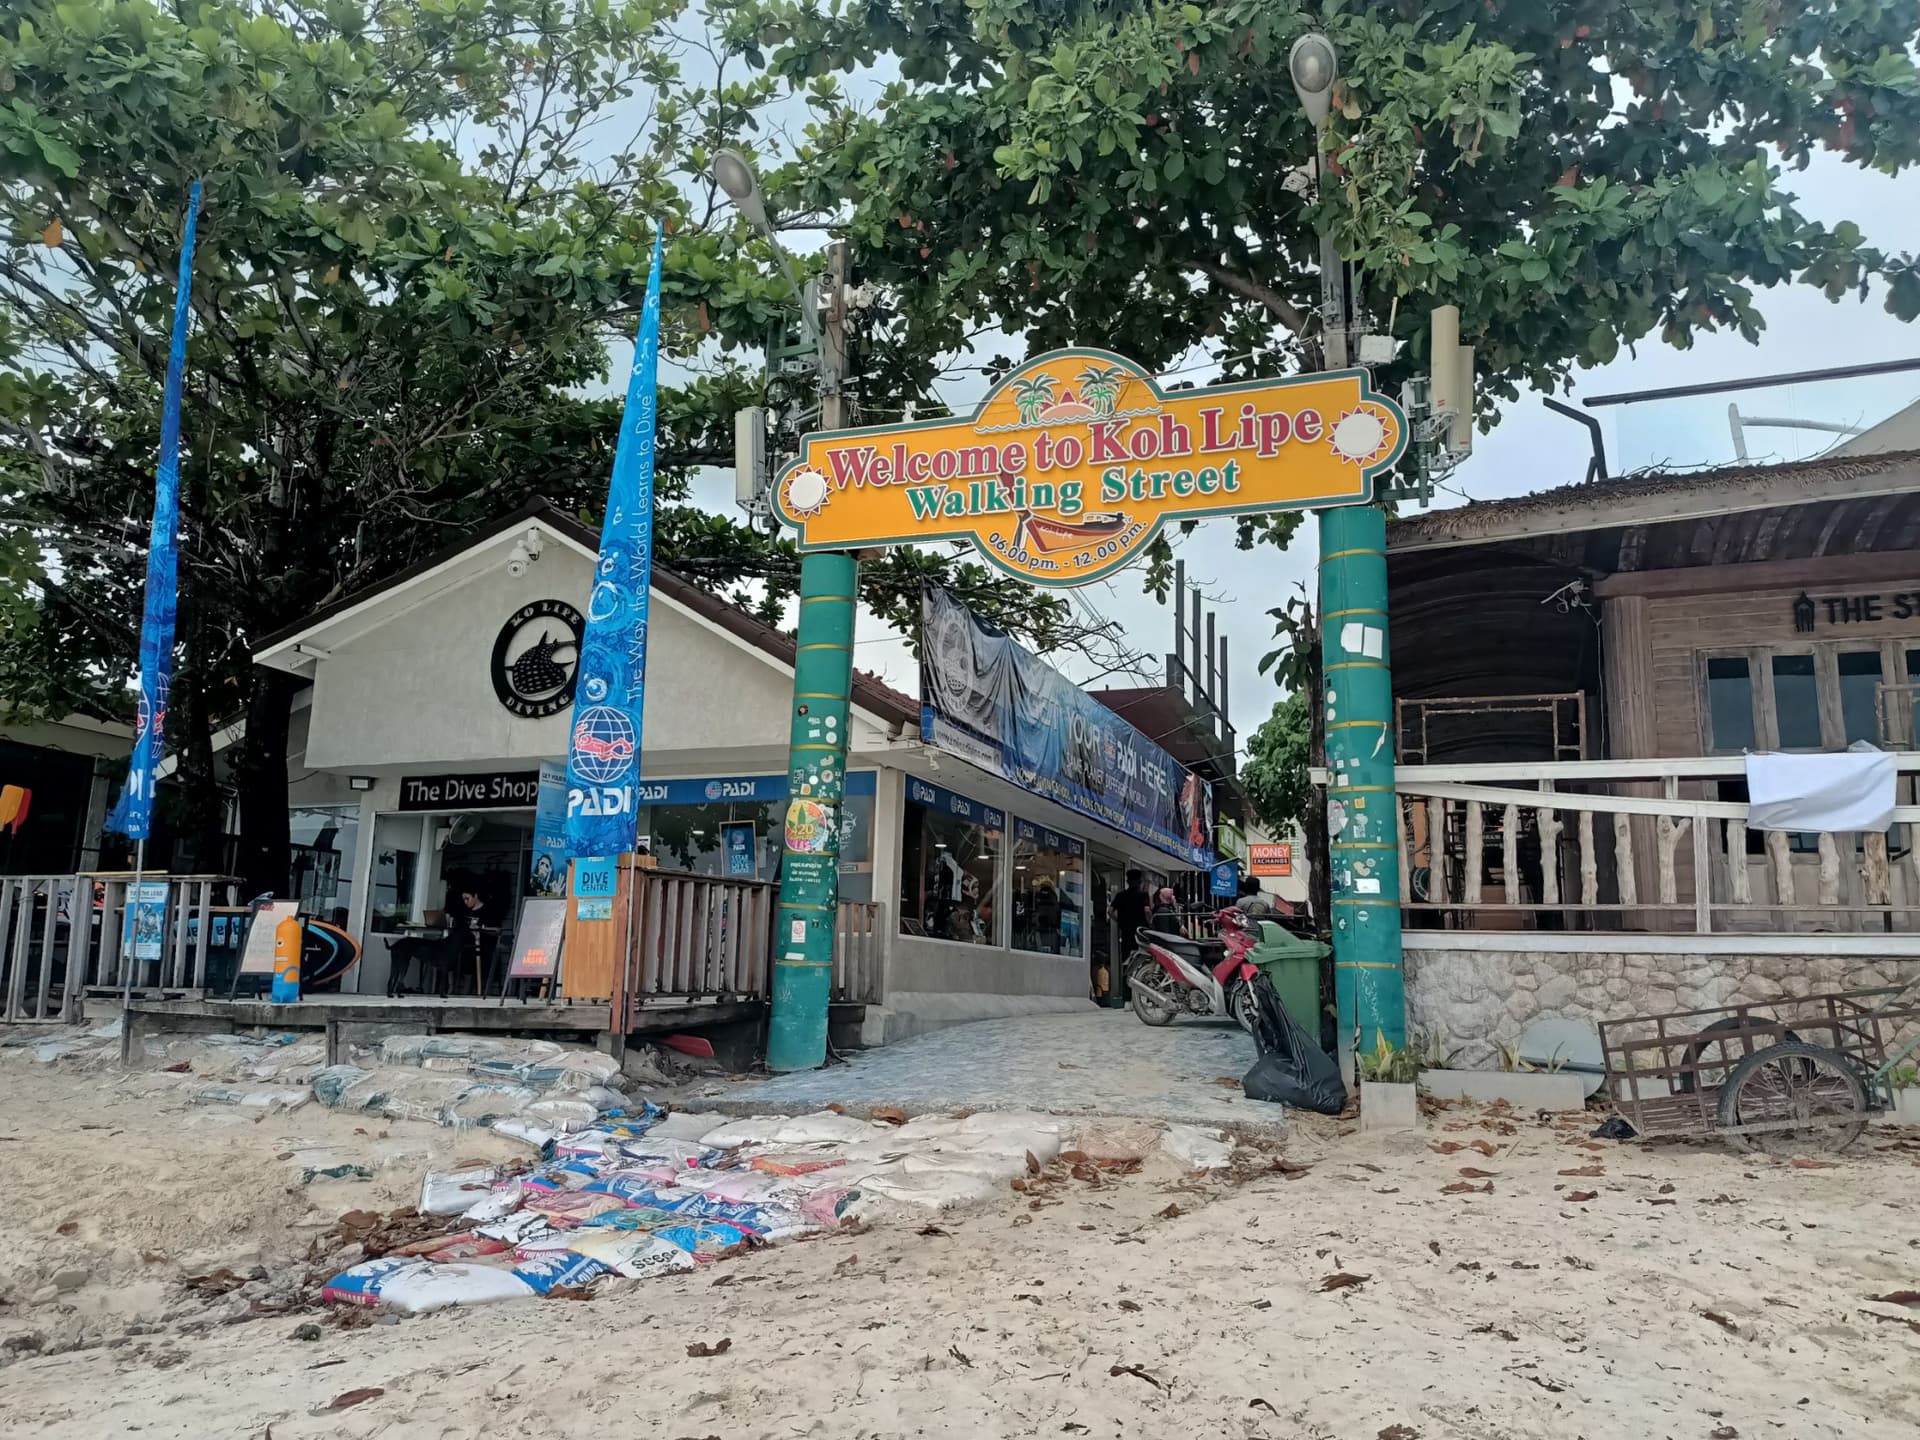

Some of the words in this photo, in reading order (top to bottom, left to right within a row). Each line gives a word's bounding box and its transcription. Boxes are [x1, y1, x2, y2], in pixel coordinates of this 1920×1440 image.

[635, 394, 652, 434] Dive
[637, 439, 651, 457] to
[826, 442, 1027, 490] Welcome
[1034, 431, 1082, 472] to
[1088, 416, 1192, 465] Koh
[1200, 405, 1323, 459] Lipe
[636, 460, 651, 518] Learns
[906, 474, 1084, 522] Walking
[1100, 457, 1242, 504] Street
[631, 519, 648, 583] World
[988, 532, 1029, 564] 06.00
[1028, 557, 1060, 570] pm.
[1072, 540, 1118, 568] 12.00
[1119, 521, 1148, 548] pm.
[511, 606, 535, 627] KO
[541, 602, 581, 625] LIPE
[632, 584, 647, 617] the
[1822, 595, 1883, 625] THE
[628, 618, 647, 666] Way
[626, 668, 643, 704] The
[506, 694, 569, 715] DIVING
[1067, 710, 1101, 757] YOUR
[1140, 755, 1168, 797] HERE
[408, 780, 440, 801] The
[445, 778, 485, 801] Dive
[489, 777, 539, 802] Shop
[567, 785, 632, 818] PADI
[639, 785, 669, 800] PADI
[723, 781, 756, 797] PADI
[920, 785, 936, 803] PADI
[546, 836, 567, 849] PADI
[1253, 847, 1288, 858] MONEY
[581, 883, 609, 892] CENTRE
[582, 871, 609, 884] DIVE
